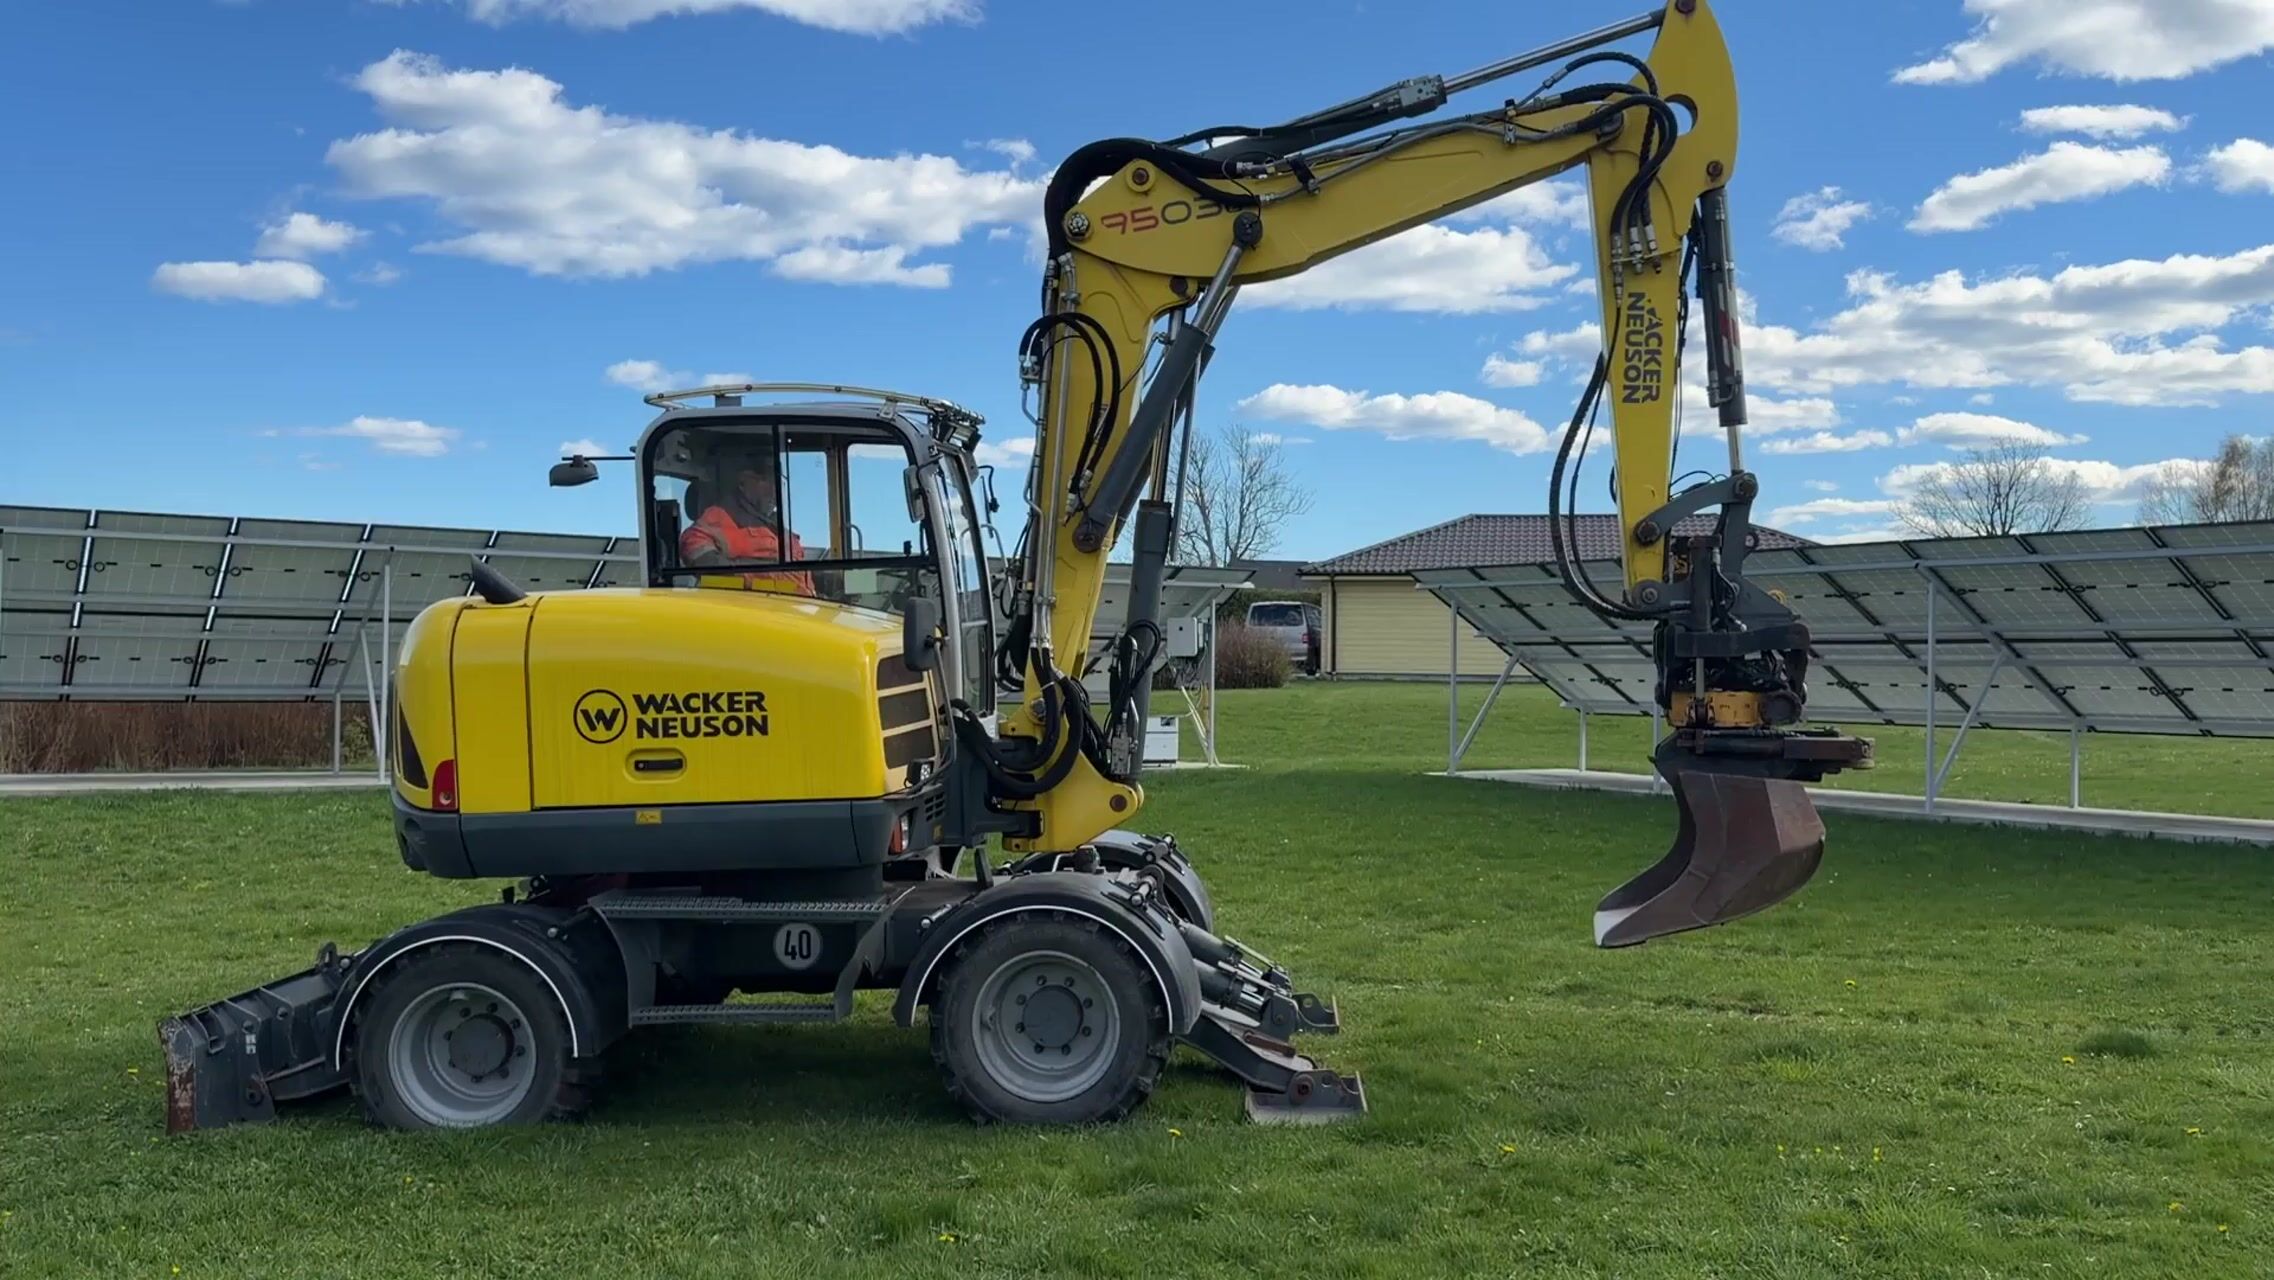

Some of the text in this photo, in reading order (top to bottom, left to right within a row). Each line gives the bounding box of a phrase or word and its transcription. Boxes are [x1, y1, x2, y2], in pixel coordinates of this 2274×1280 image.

[1622, 291, 1646, 404] NEUSON
[1641, 299, 1663, 404] ACKER
[632, 691, 768, 715] WACKER
[579, 707, 621, 732] W
[636, 714, 769, 739] NEUSON
[784, 929, 811, 960] 40
